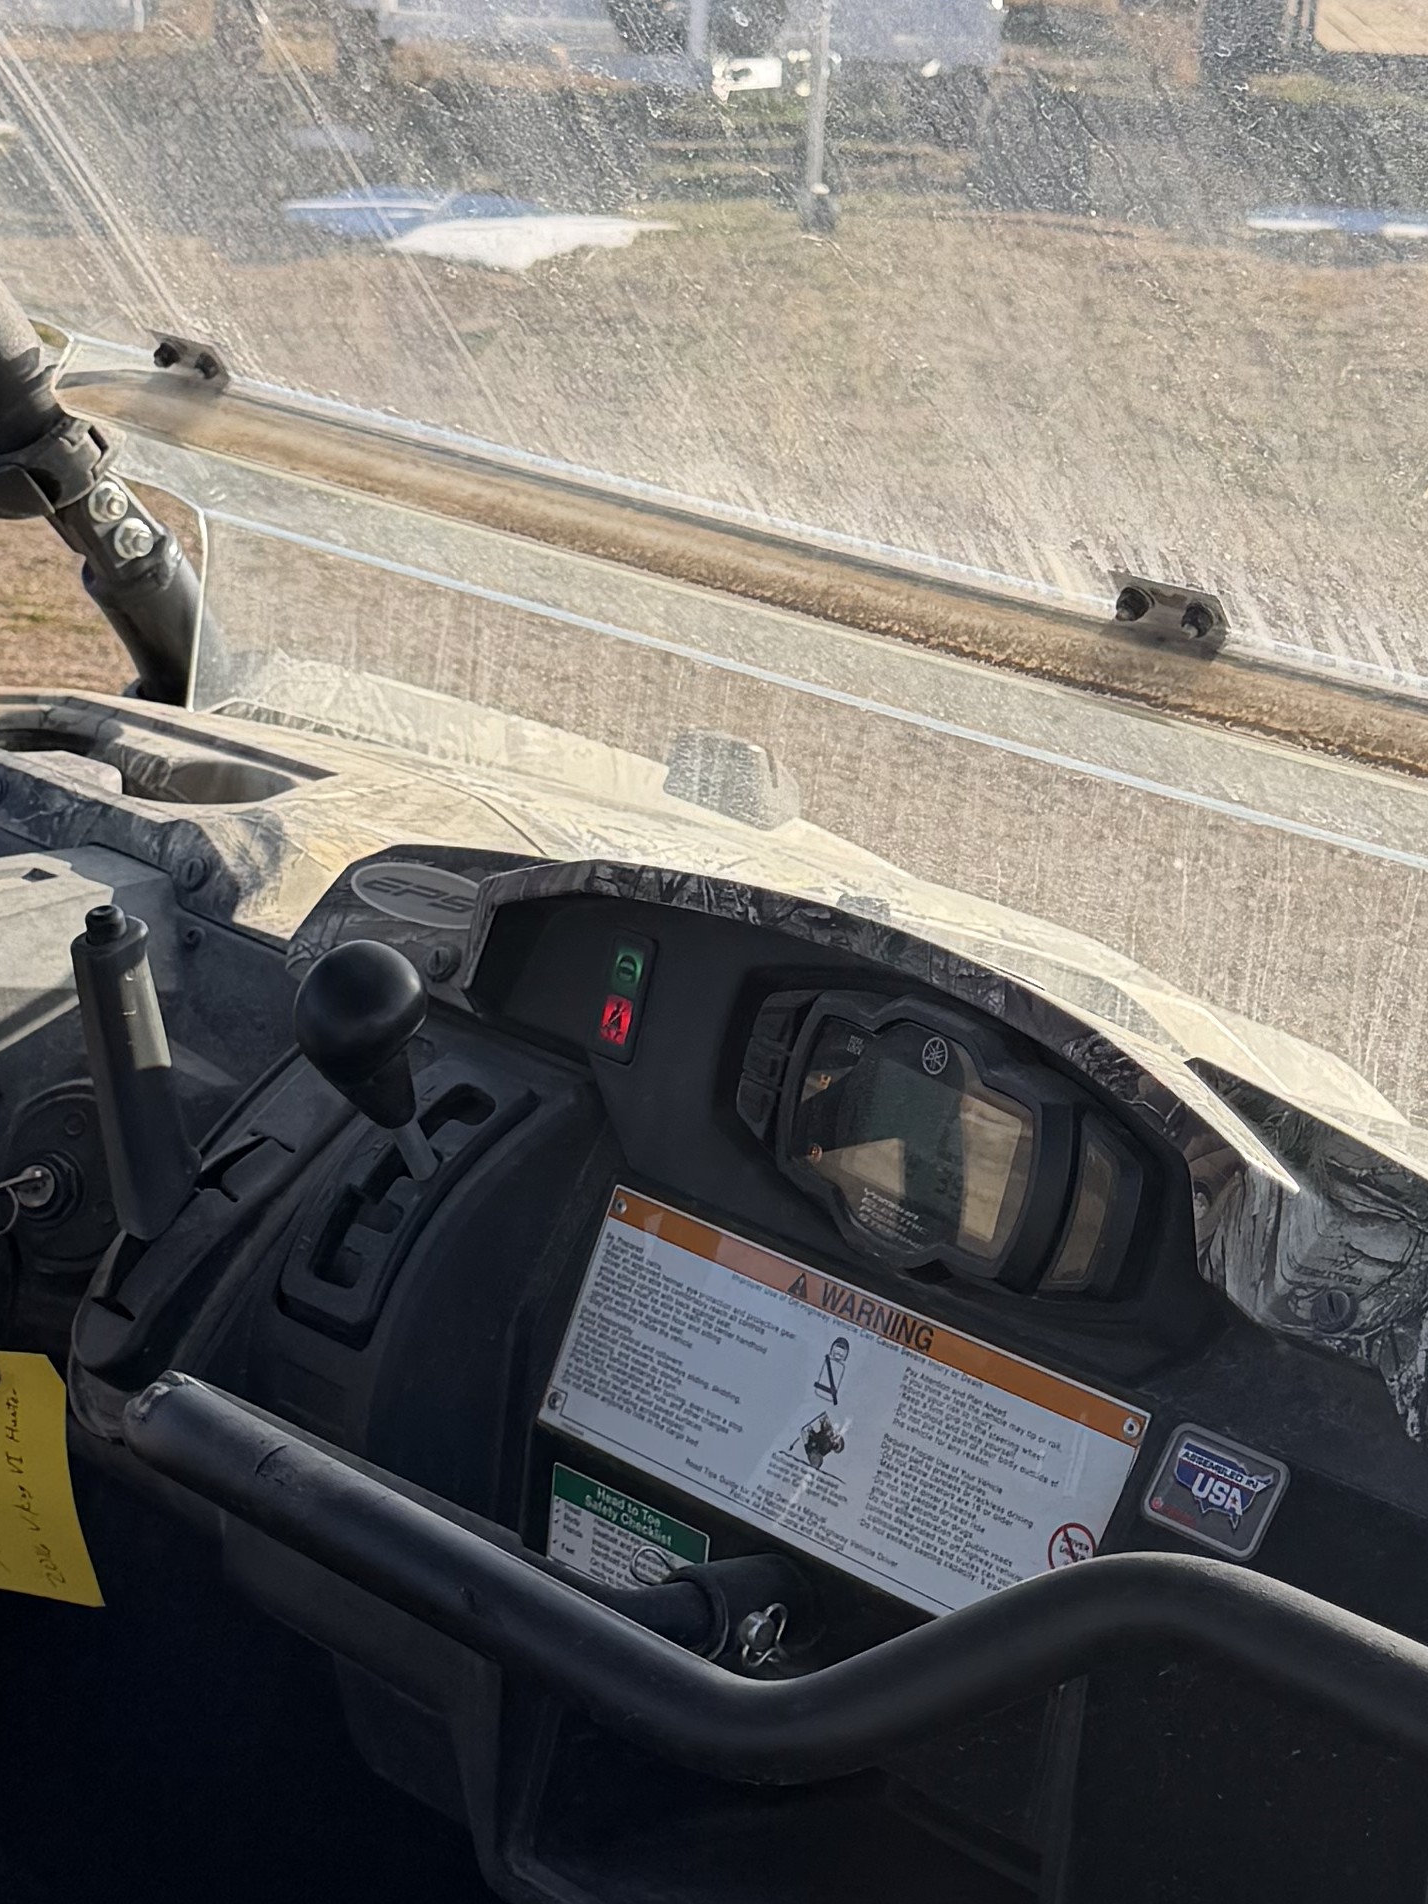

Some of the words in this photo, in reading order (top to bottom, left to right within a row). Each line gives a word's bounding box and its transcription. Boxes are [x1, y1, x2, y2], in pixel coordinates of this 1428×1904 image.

[817, 1282, 936, 1352] WARNING
[908, 1379, 922, 1390] you
[967, 1403, 979, 1414] the
[980, 1409, 1008, 1427] vehicle
[1007, 1423, 1024, 1436] may
[926, 1396, 944, 1409] your
[951, 1387, 966, 1399] and
[899, 1392, 920, 1407] Keep
[973, 1424, 987, 1436] the
[987, 1431, 1019, 1452] steering
[944, 1421, 959, 1433] and
[960, 1428, 983, 1444] brace
[906, 1423, 933, 1441] vehicle
[946, 1443, 960, 1455] any
[935, 1428, 950, 1440] any
[978, 1448, 996, 1461] your
[932, 1465, 959, 1484] prevent
[935, 1457, 950, 1469] Use
[1182, 1451, 1243, 1483] ASSEMBLED
[1244, 1475, 1260, 1490] IN
[596, 1486, 625, 1510] Head
[626, 1502, 639, 1516] to
[900, 1470, 917, 1482] sure
[956, 1496, 969, 1506] are
[1191, 1472, 1243, 1516] USA
[583, 1493, 619, 1522] Safety
[619, 1511, 672, 1546] Checklist
